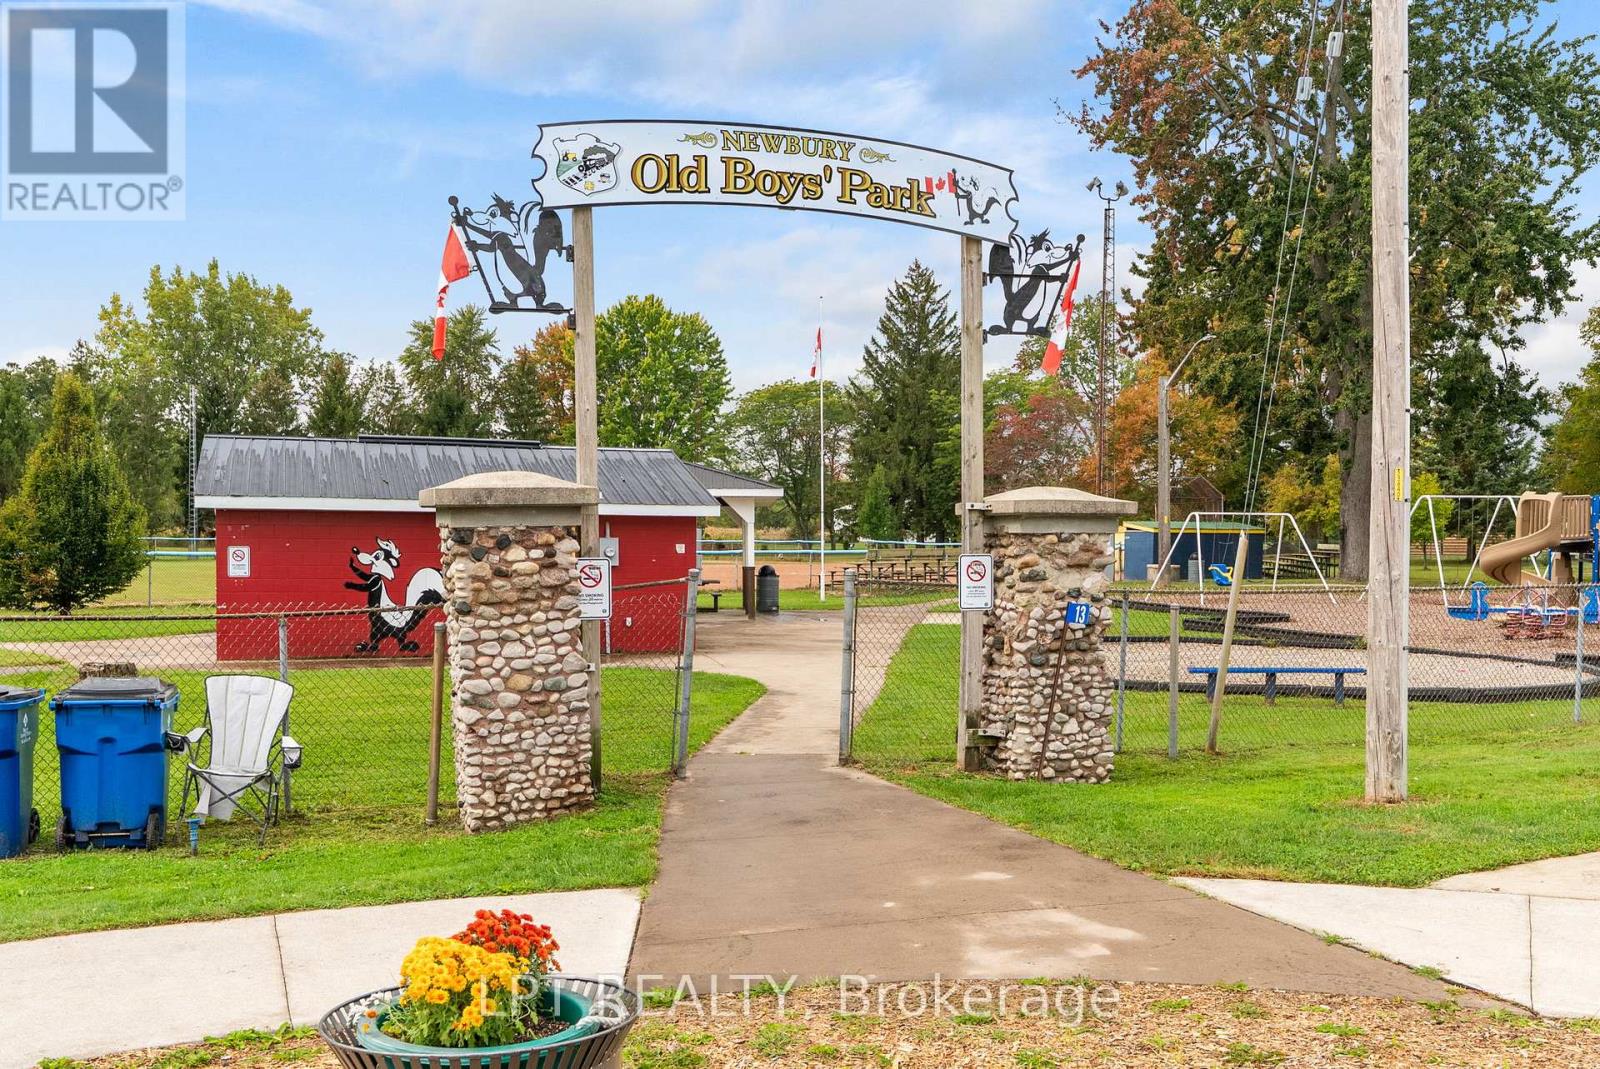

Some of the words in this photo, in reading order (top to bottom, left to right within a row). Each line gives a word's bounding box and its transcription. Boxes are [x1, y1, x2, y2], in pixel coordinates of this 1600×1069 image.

[721, 130, 856, 162] NEWBURY
[631, 153, 710, 194] Old
[721, 156, 833, 204] Boys'
[837, 166, 936, 218] Park
[1075, 605, 1087, 624] 13
